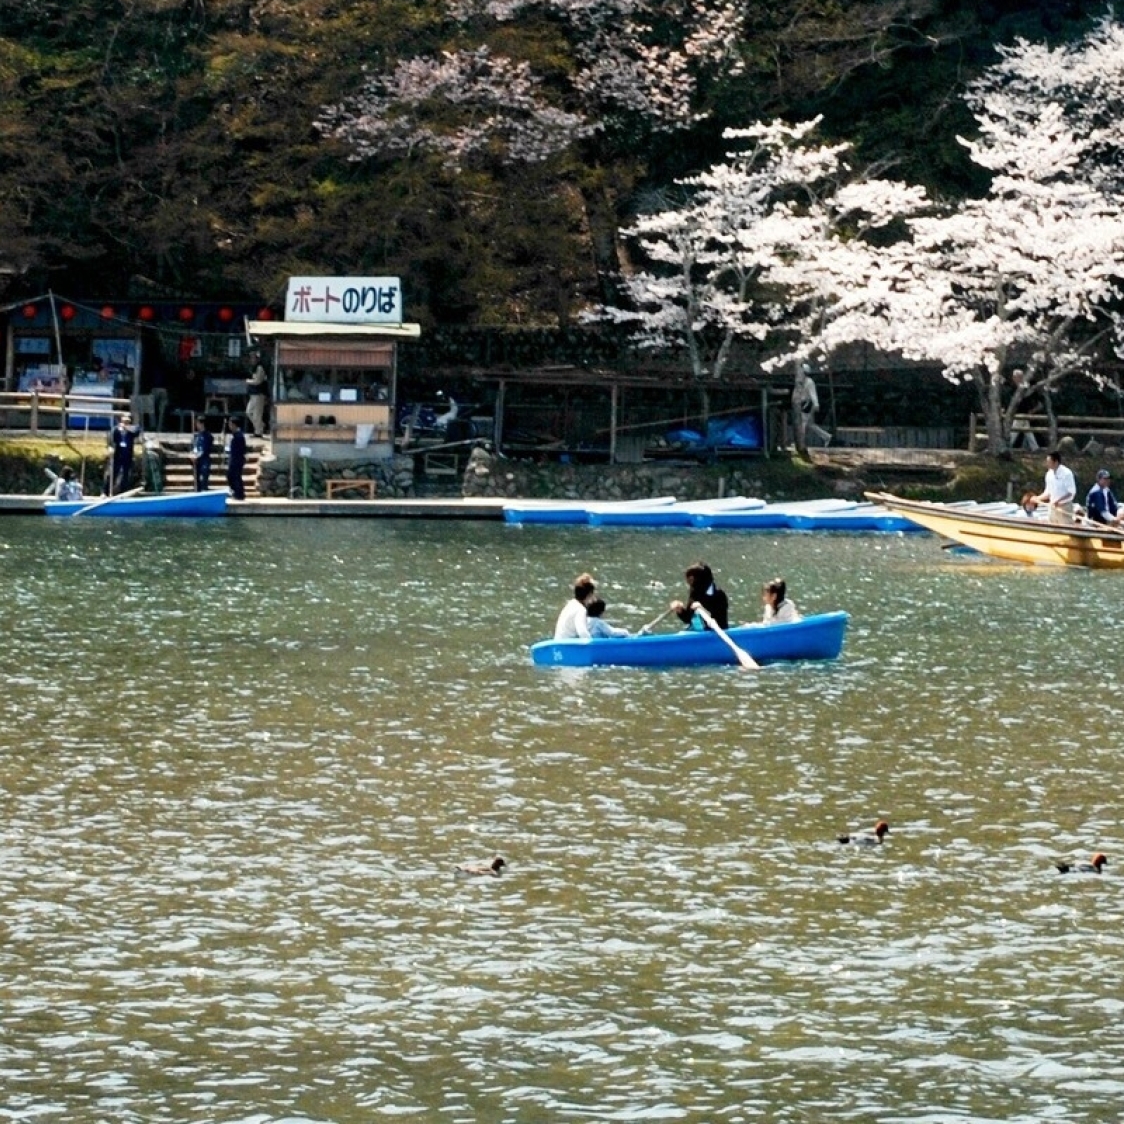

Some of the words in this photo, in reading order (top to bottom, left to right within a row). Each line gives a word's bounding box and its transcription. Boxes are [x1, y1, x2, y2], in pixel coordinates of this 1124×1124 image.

[292, 285, 398, 314] ボートのりば
